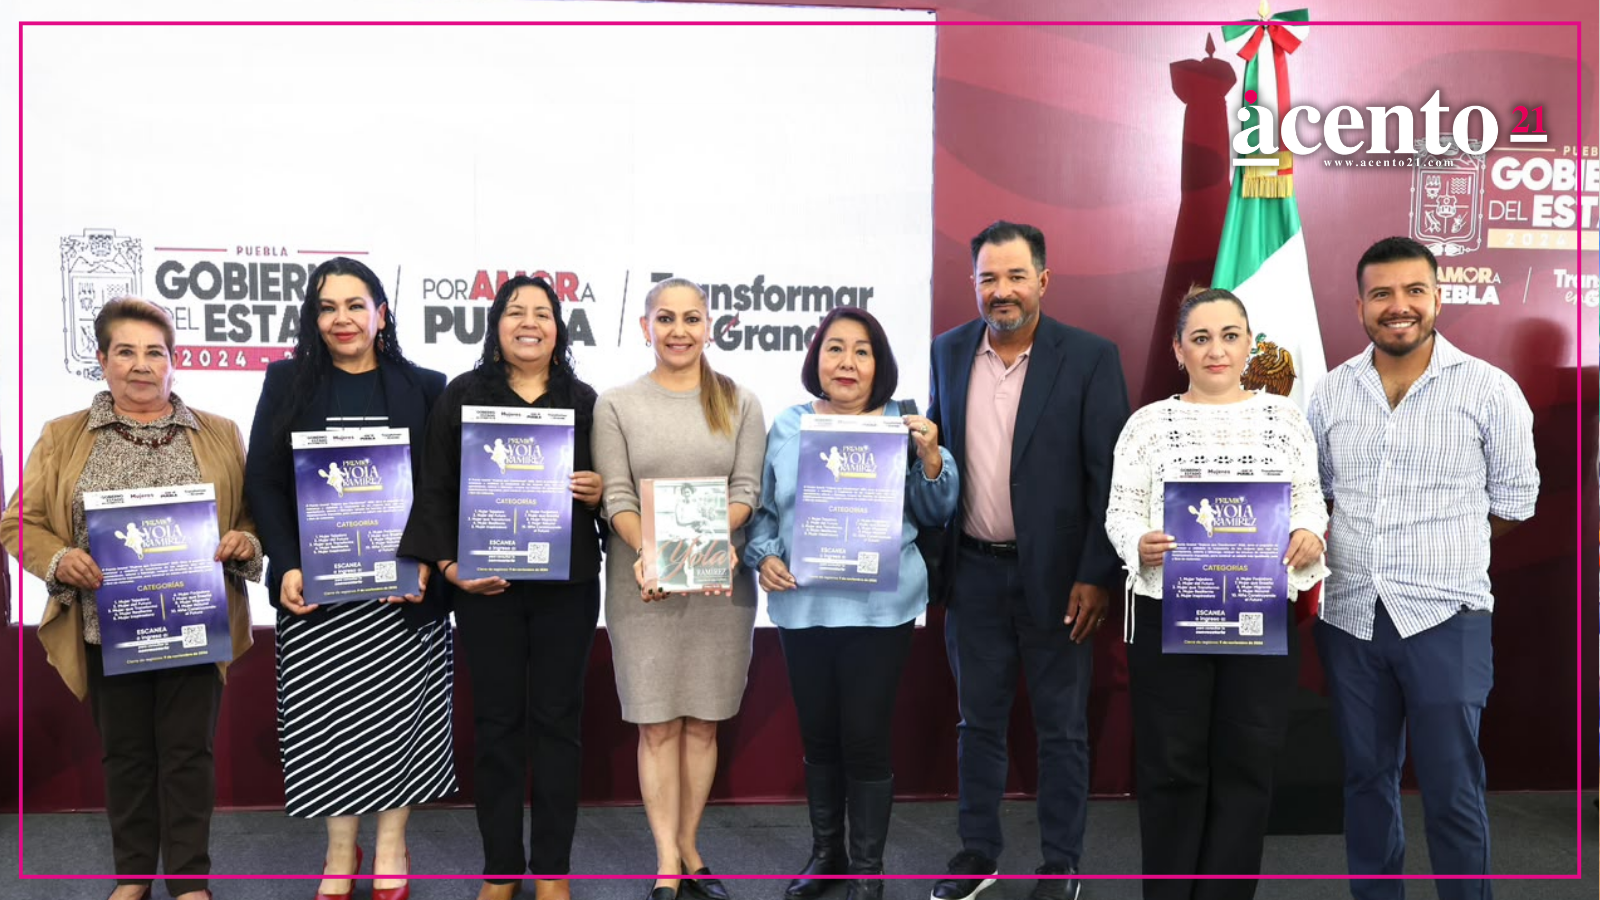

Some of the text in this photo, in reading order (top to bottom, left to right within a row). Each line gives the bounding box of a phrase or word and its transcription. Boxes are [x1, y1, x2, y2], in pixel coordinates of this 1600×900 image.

[1488, 194, 1599, 229] DEL EST
[236, 245, 289, 257] PUEBLA
[155, 259, 318, 302] GOBIER
[422, 278, 468, 300] POR
[1553, 268, 1599, 289] Tran
[650, 272, 874, 312] nsformar
[1437, 284, 1500, 305] EBLA
[204, 303, 301, 343] ESTA
[424, 305, 597, 347] PUA
[713, 314, 825, 352] Gran
[181, 350, 248, 368] 2024
[336, 518, 378, 528] CATEGORÍAS
[1202, 563, 1248, 571] CATEGORÍAS
[136, 580, 184, 592] CATEGORÍAS
